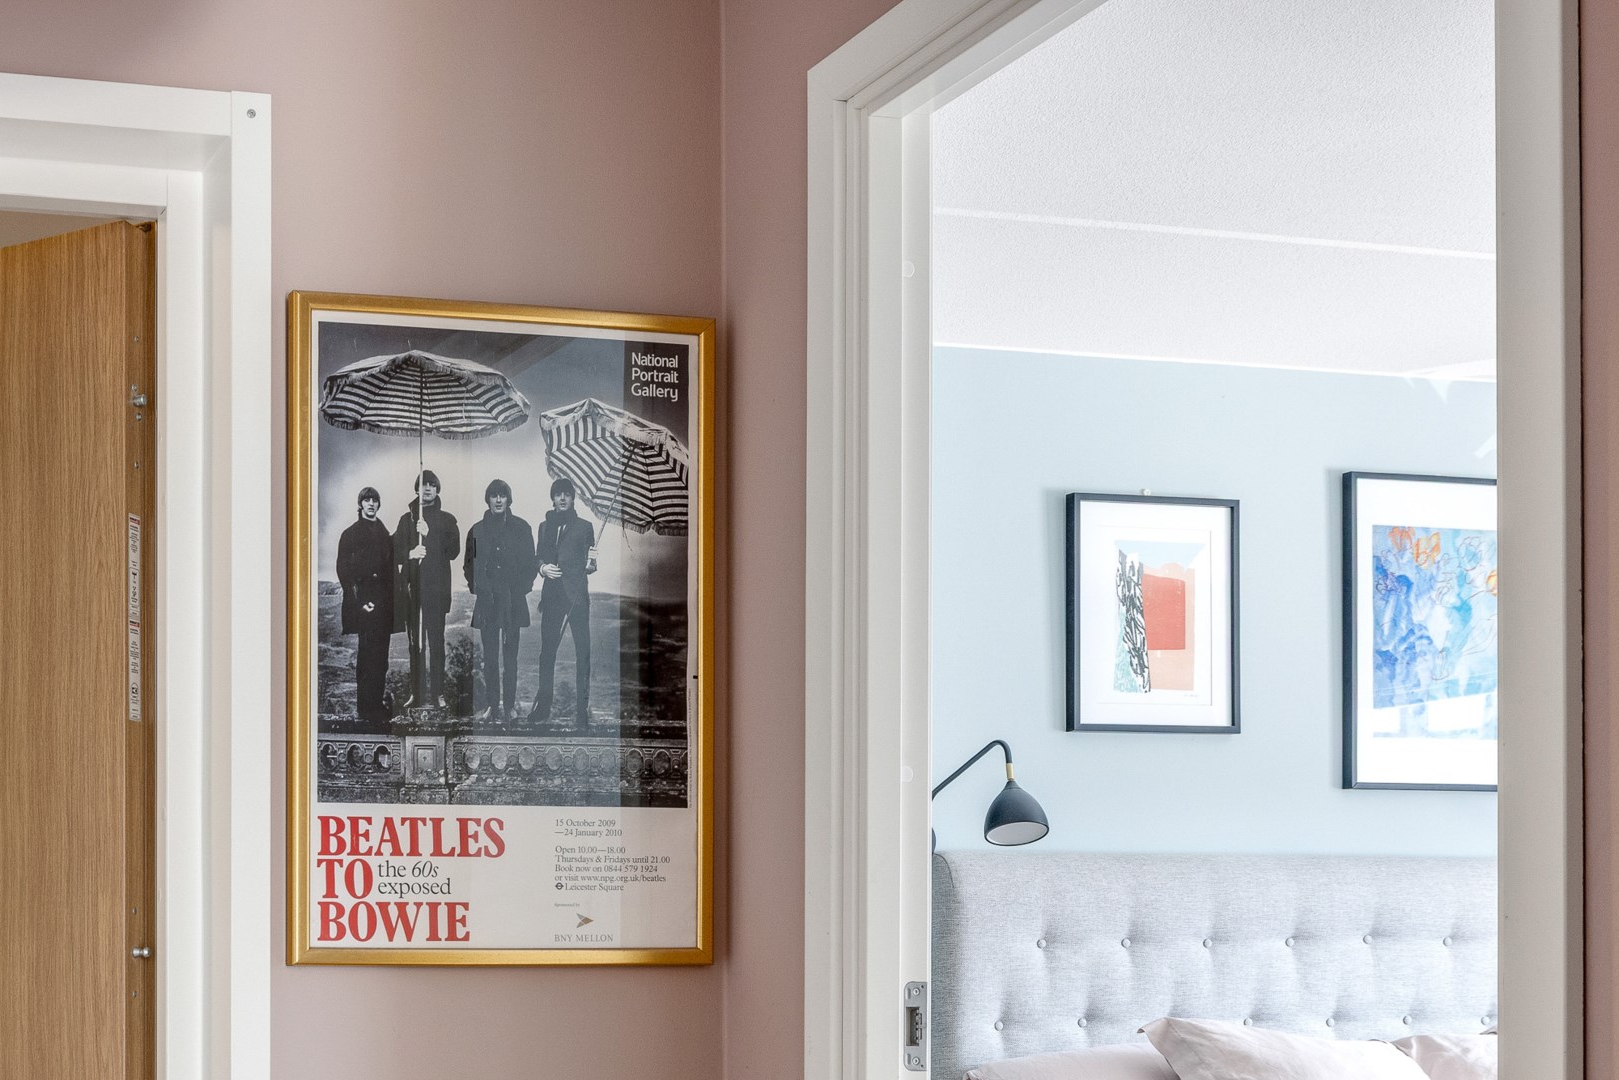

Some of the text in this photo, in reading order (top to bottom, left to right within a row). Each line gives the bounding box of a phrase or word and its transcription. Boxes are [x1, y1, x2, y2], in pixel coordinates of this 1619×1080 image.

[631, 352, 679, 369] National
[631, 367, 679, 383] Portrait
[631, 383, 678, 402] Gallery
[555, 819, 564, 827] 15
[566, 819, 596, 827] October
[317, 816, 506, 858] BEATLES
[574, 829, 604, 838] January
[605, 829, 623, 837] 2010
[555, 846, 576, 854] Open
[555, 855, 594, 864] Thursdays
[604, 856, 631, 865] Fridays
[378, 860, 439, 878] the 60s
[603, 865, 622, 873] 0844
[624, 865, 638, 873] 579
[641, 865, 658, 873] 1924
[317, 859, 373, 899] TO
[580, 875, 667, 883] www.npg.org.uk/beatles
[378, 878, 452, 898] exposed
[565, 883, 624, 892] Leicester Square
[317, 901, 471, 943] BOWIE
[555, 934, 614, 942] BNY MELLON
